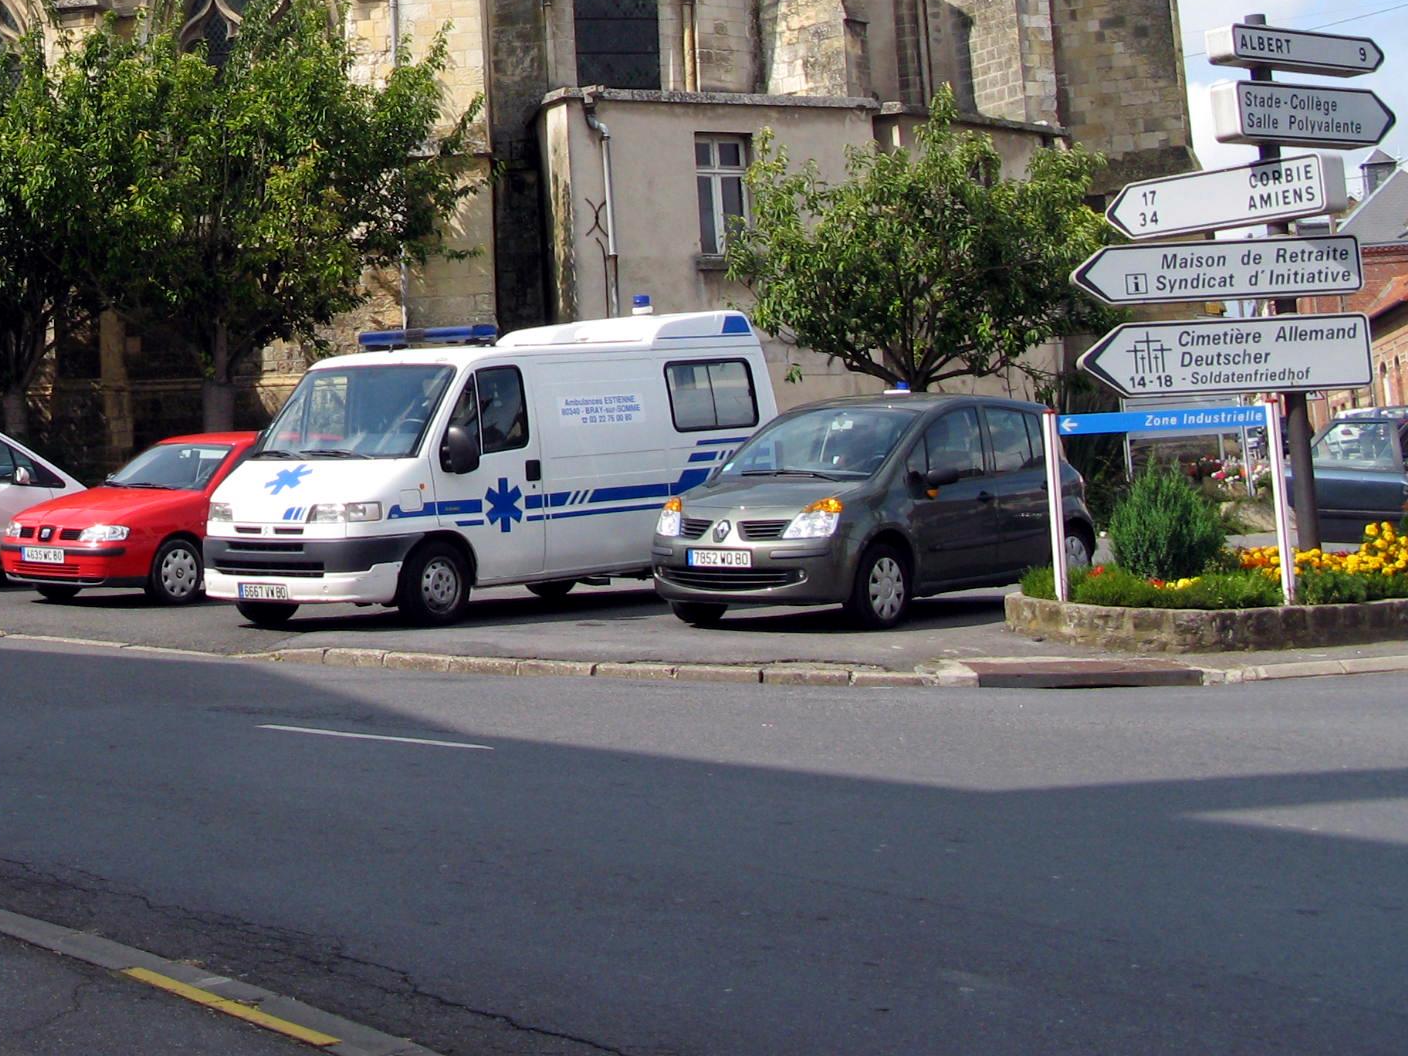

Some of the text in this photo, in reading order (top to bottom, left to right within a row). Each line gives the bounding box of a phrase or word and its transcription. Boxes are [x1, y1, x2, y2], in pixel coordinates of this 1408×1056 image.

[1240, 34, 1291, 54] ALBERT
[1359, 47, 1367, 62] 9
[1247, 112, 1362, 134] Salle Polyvalente
[1142, 164, 1314, 206] 17 CORBIE
[1139, 185, 1315, 227] 34 AMIENS
[1161, 246, 1349, 270] Maison de Retraite
[1156, 273, 1235, 293] Syndicat
[1178, 322, 1357, 347] Cimetière Allemand
[1180, 349, 1271, 368] Deutscher
[1129, 374, 1173, 389] 14-18
[1144, 411, 1263, 426] Zone Industrielle
[694, 552, 718, 564] 7852
[735, 553, 748, 565] 80
